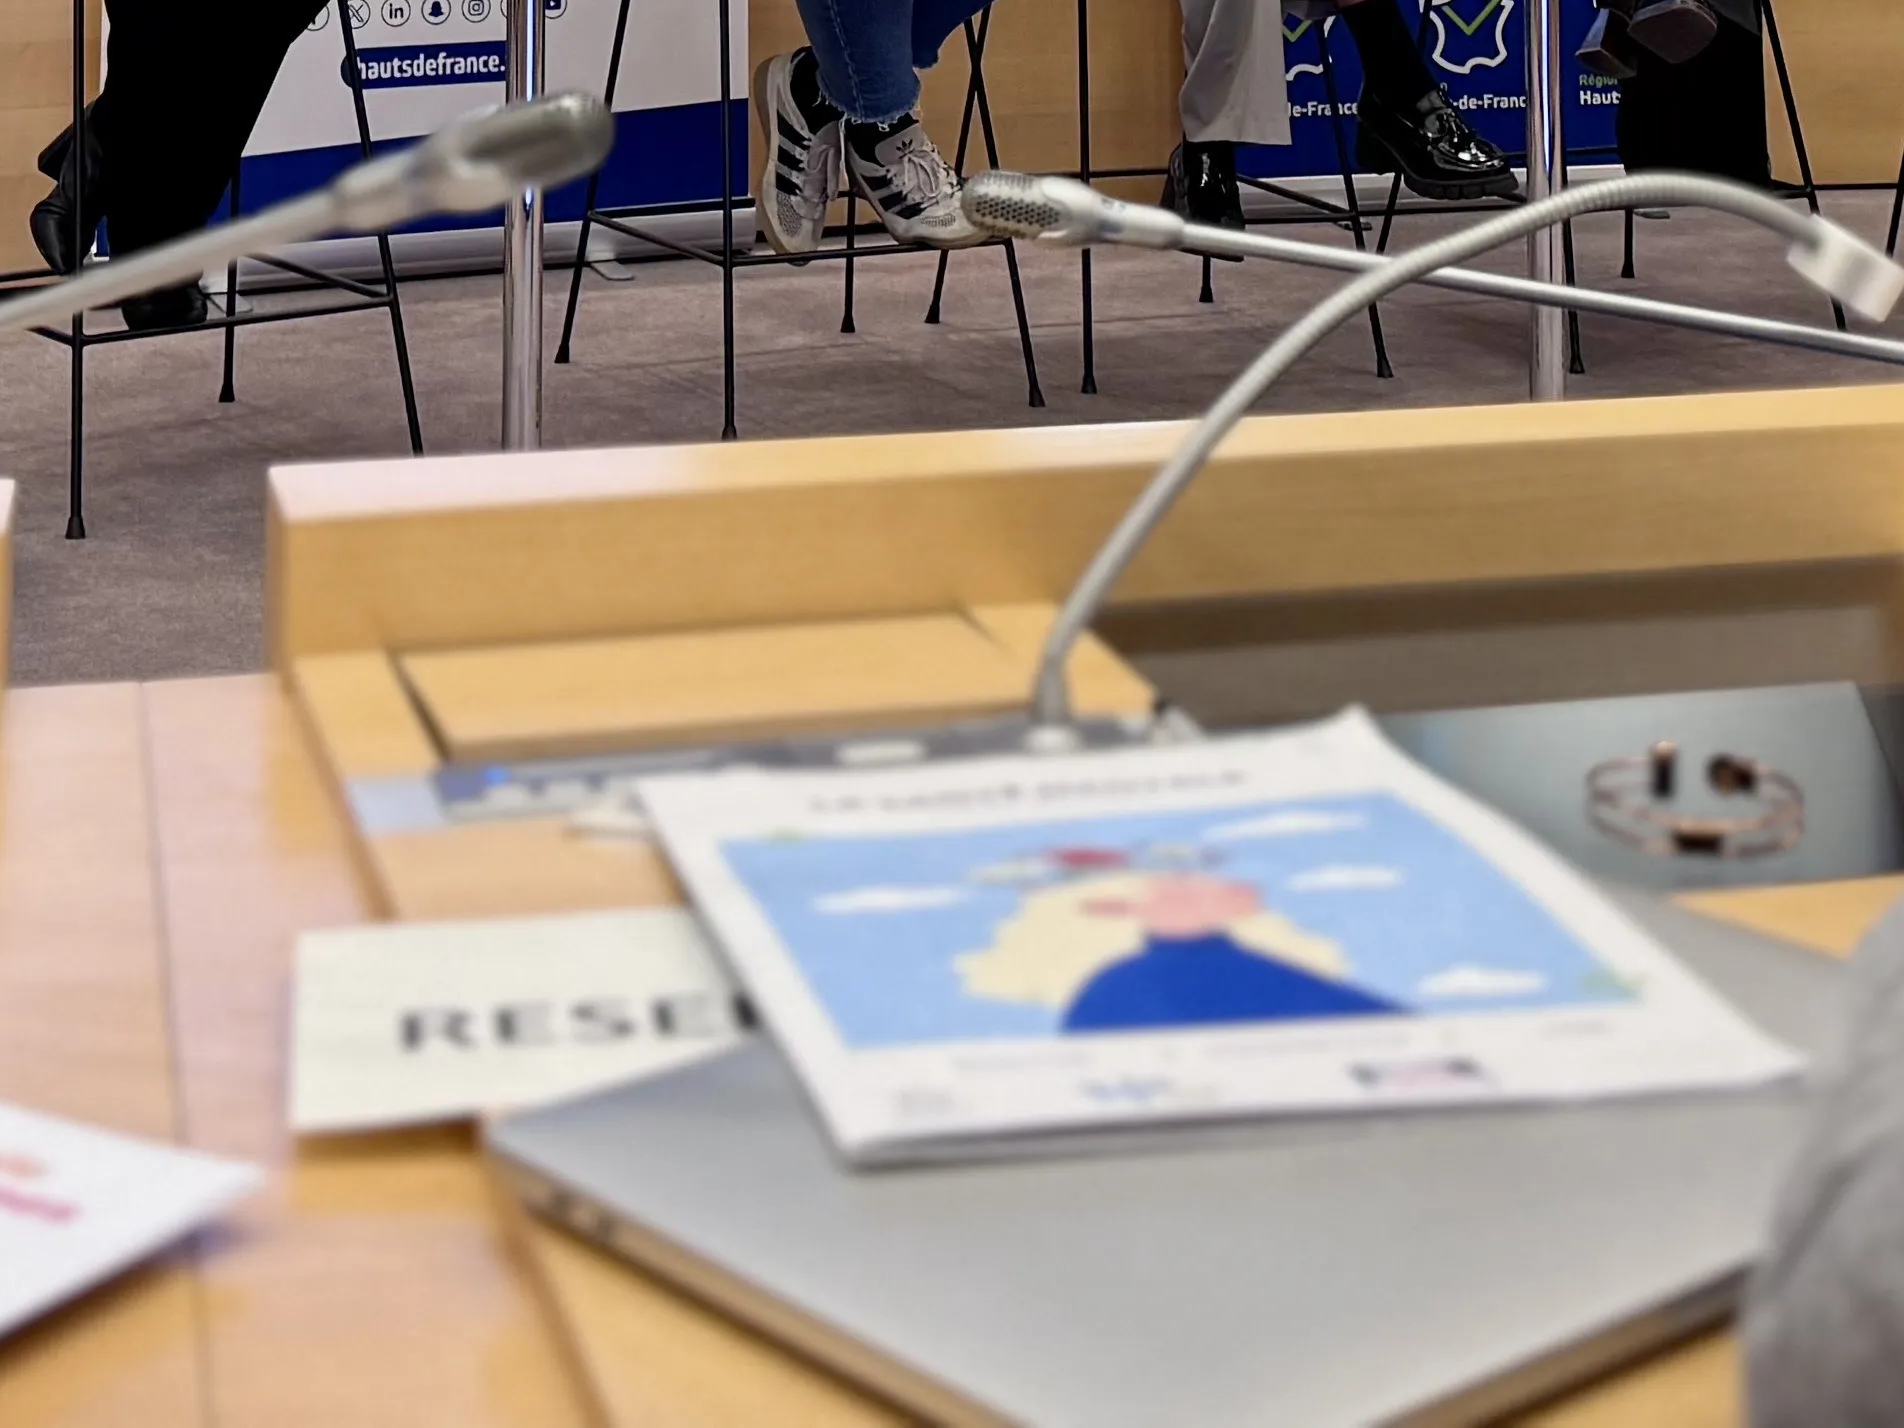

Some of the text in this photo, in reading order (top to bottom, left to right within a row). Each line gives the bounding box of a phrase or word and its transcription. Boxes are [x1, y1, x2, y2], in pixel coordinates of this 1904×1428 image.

[357, 51, 506, 80] hautsdefrance.
[1453, 93, 1527, 110] -de-Franc
[399, 988, 764, 1054] RESE
